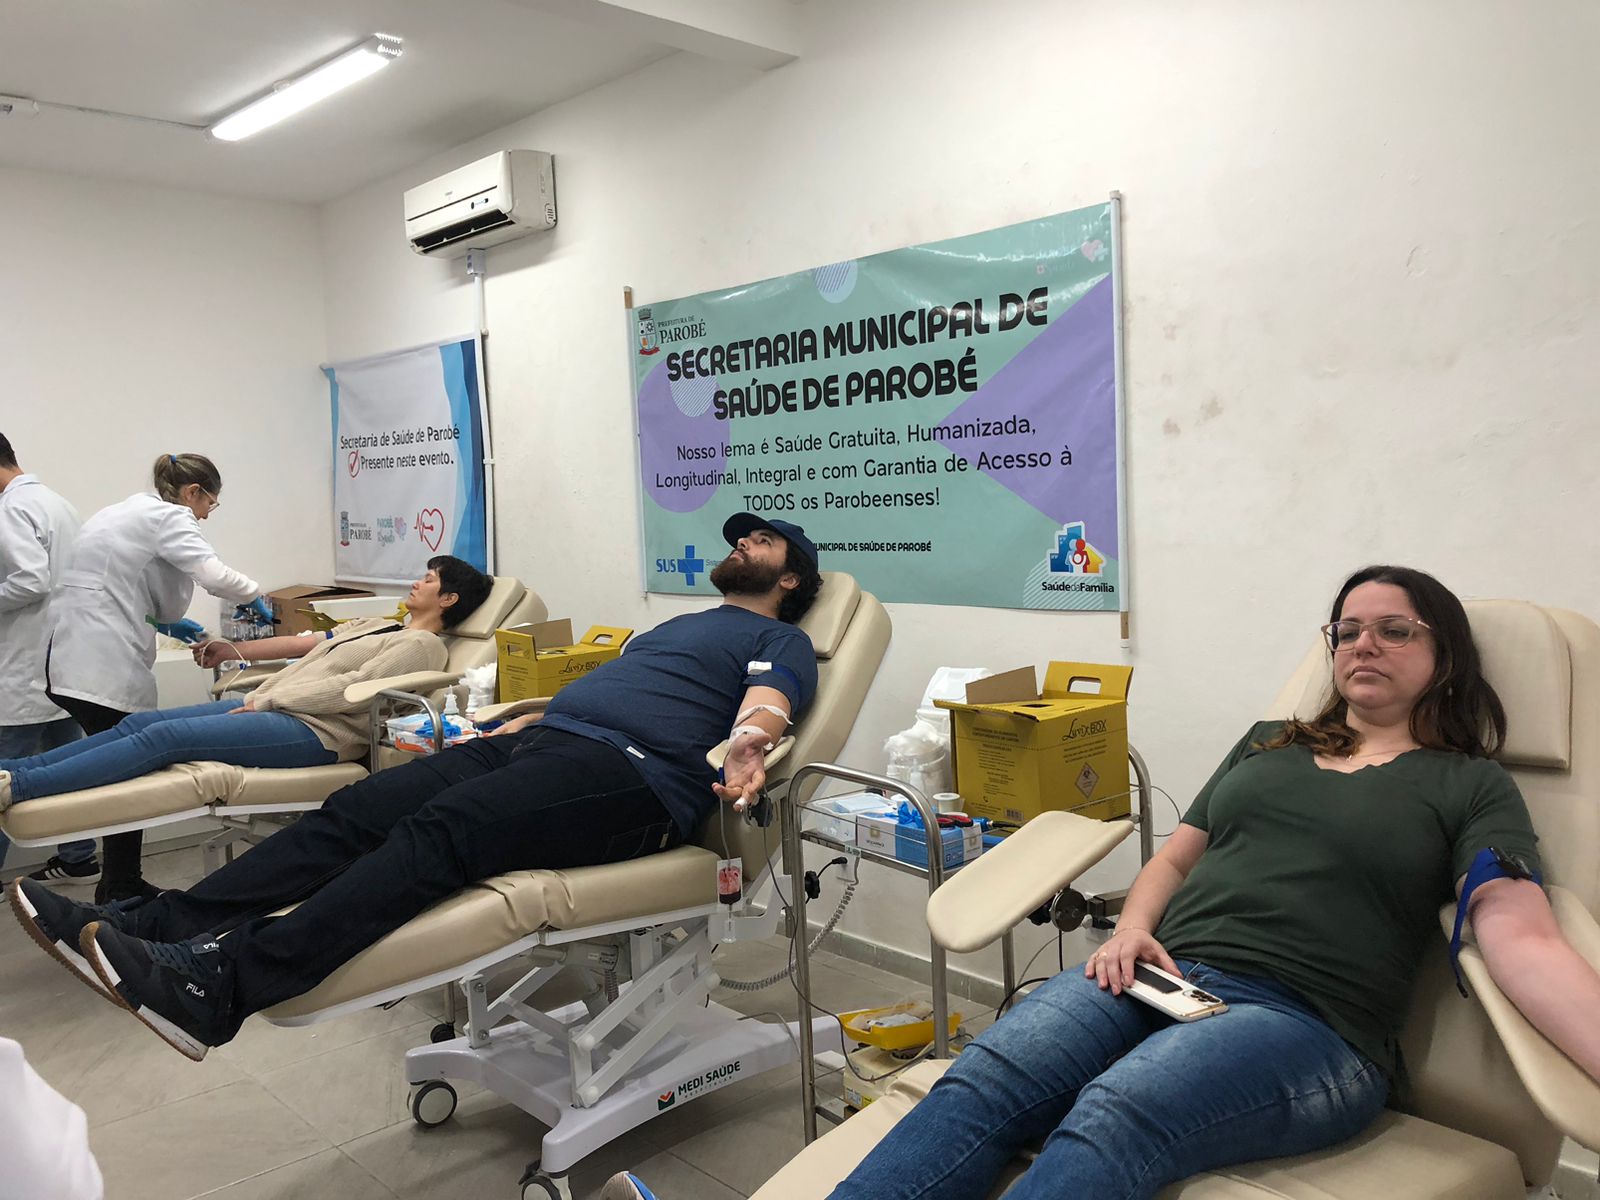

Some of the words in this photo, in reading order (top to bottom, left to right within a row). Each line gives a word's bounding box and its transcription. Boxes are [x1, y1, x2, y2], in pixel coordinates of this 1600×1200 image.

[659, 318, 707, 344] PAROBÉ
[666, 329, 818, 382] SECRETARIA
[823, 298, 990, 359] MUNICIPAL
[998, 287, 1048, 332] DE
[713, 377, 798, 420] SAÚDE
[803, 374, 840, 411] DE
[845, 347, 978, 406] PAROBÉ
[340, 433, 378, 449] Secretaria
[380, 432, 390, 447] de
[391, 429, 414, 446] Saúde
[415, 428, 425, 442] de
[427, 424, 460, 442] Parobé
[677, 445, 716, 461] Nosso
[721, 442, 755, 457] lema
[761, 438, 769, 454] é
[775, 433, 822, 453] Saúde
[828, 427, 900, 449] Gratuita,
[907, 415, 1036, 443] Humanizada,
[360, 455, 394, 469] Presente
[396, 453, 416, 467] neste
[419, 451, 454, 466] evento.
[656, 469, 741, 491] Longitudinal,
[745, 464, 801, 487] Integral
[807, 467, 816, 479] e
[822, 464, 857, 479] com
[863, 455, 937, 477] Garantia
[944, 454, 968, 472] de
[976, 451, 1052, 471] Acesso
[1060, 445, 1072, 465] à
[743, 493, 795, 511] TODOS
[801, 496, 818, 510] os
[824, 487, 940, 509] Parobeenses!
[848, 542, 858, 552] DE
[860, 541, 885, 552] SAÚDE
[886, 542, 897, 552] DE
[897, 541, 932, 552] PAROBÉ
[656, 558, 676, 573] SUS
[185, 982, 205, 997] FILA
[678, 1076, 703, 1096] MEDI
[705, 1061, 741, 1083] SAÚDE
